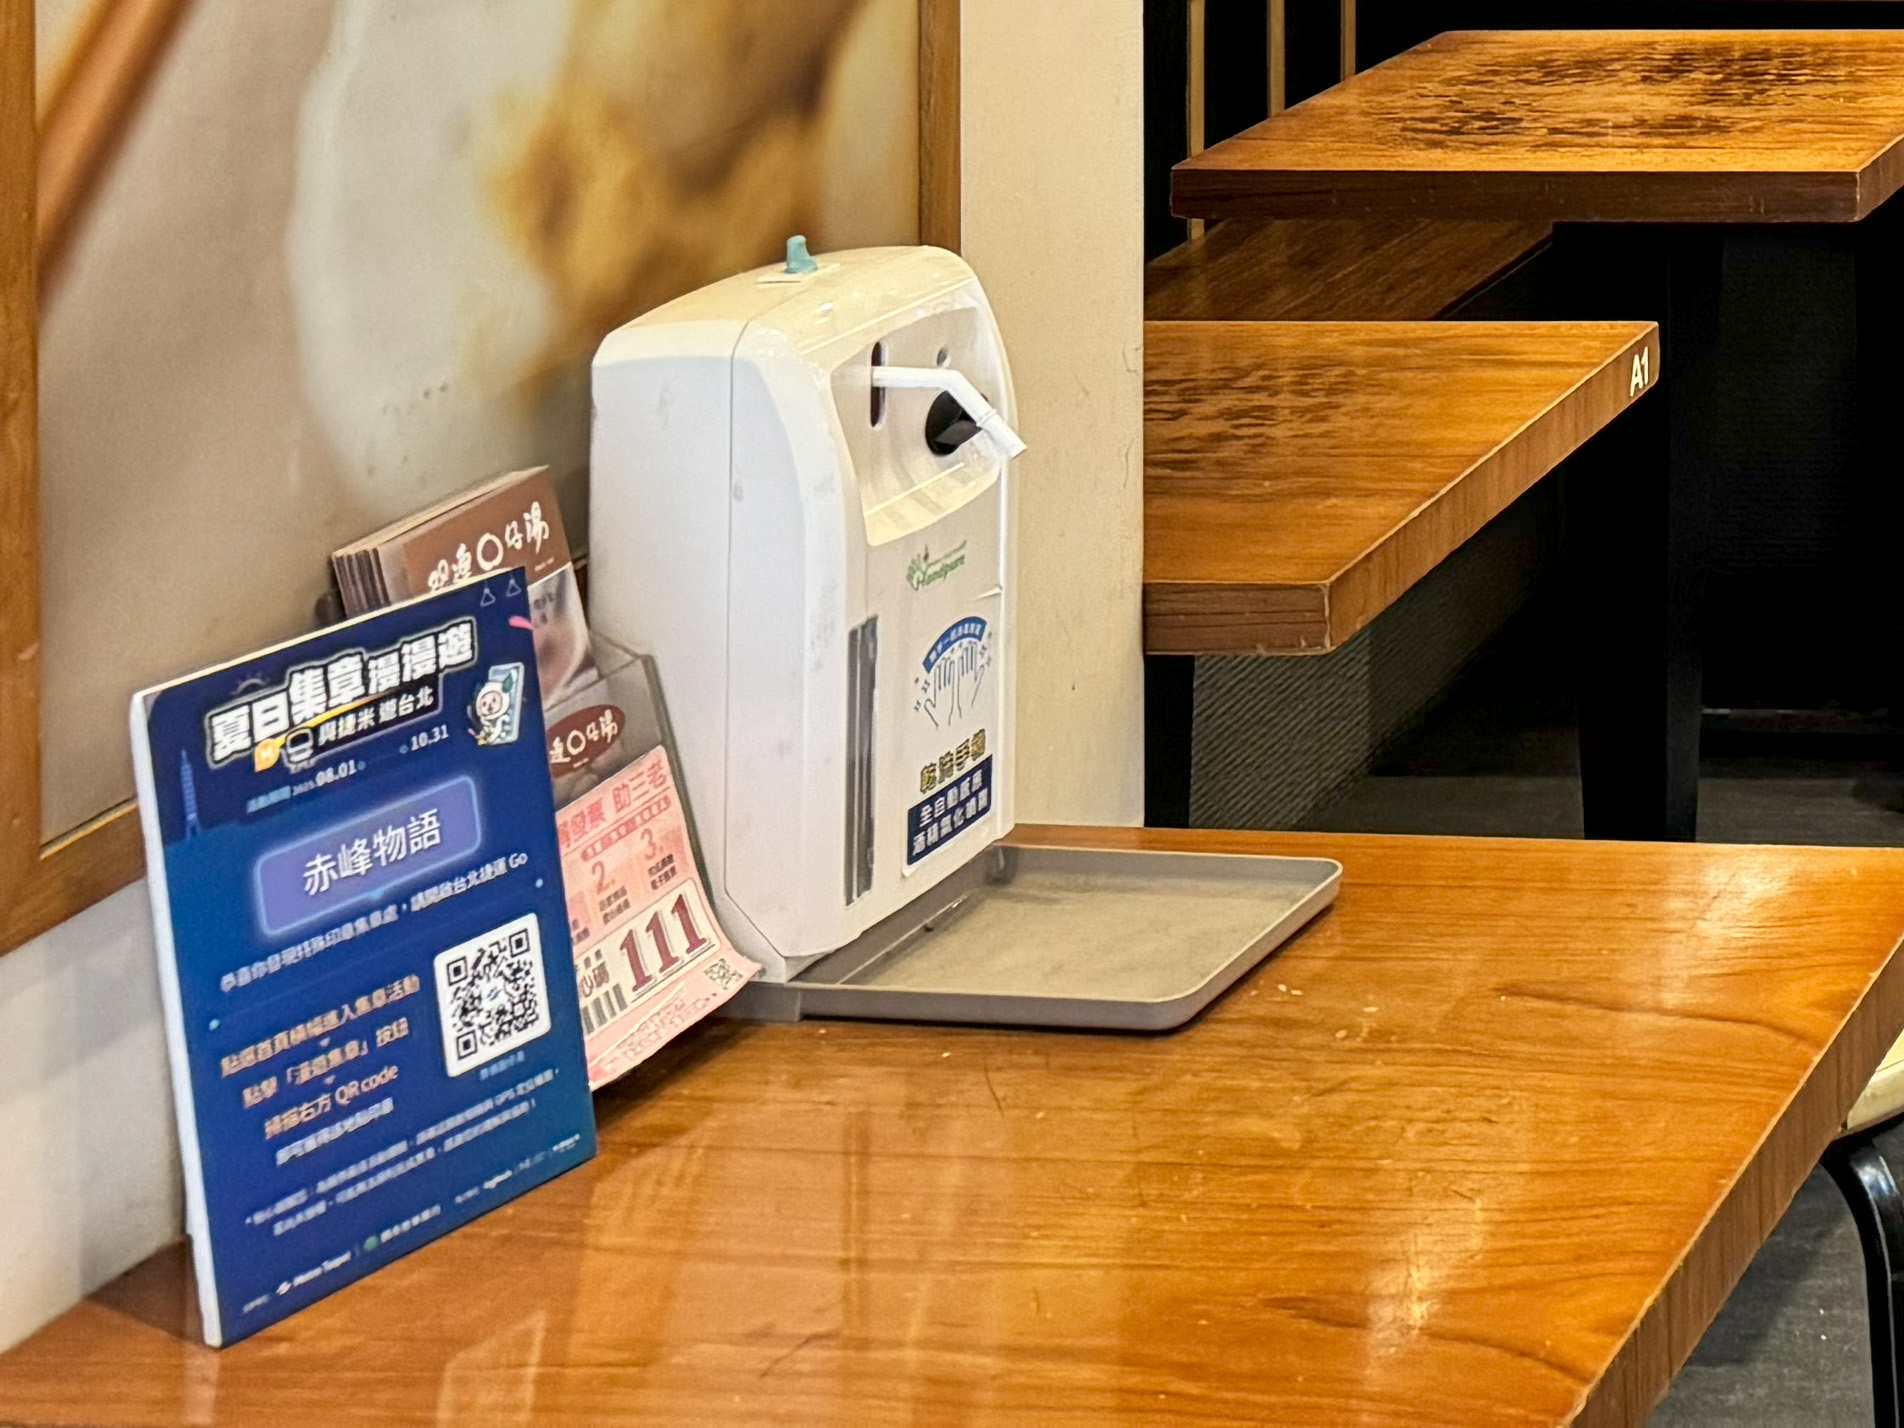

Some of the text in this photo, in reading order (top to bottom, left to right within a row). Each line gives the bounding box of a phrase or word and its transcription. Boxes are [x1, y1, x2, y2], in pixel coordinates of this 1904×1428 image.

[1629, 346, 1649, 398] A1
[409, 724, 449, 752] 10.31
[303, 808, 441, 897] 赤峰物語
[508, 852, 529, 870] Go
[619, 892, 709, 994] 111
[334, 1080, 361, 1106] QR
[360, 1064, 400, 1093] code
